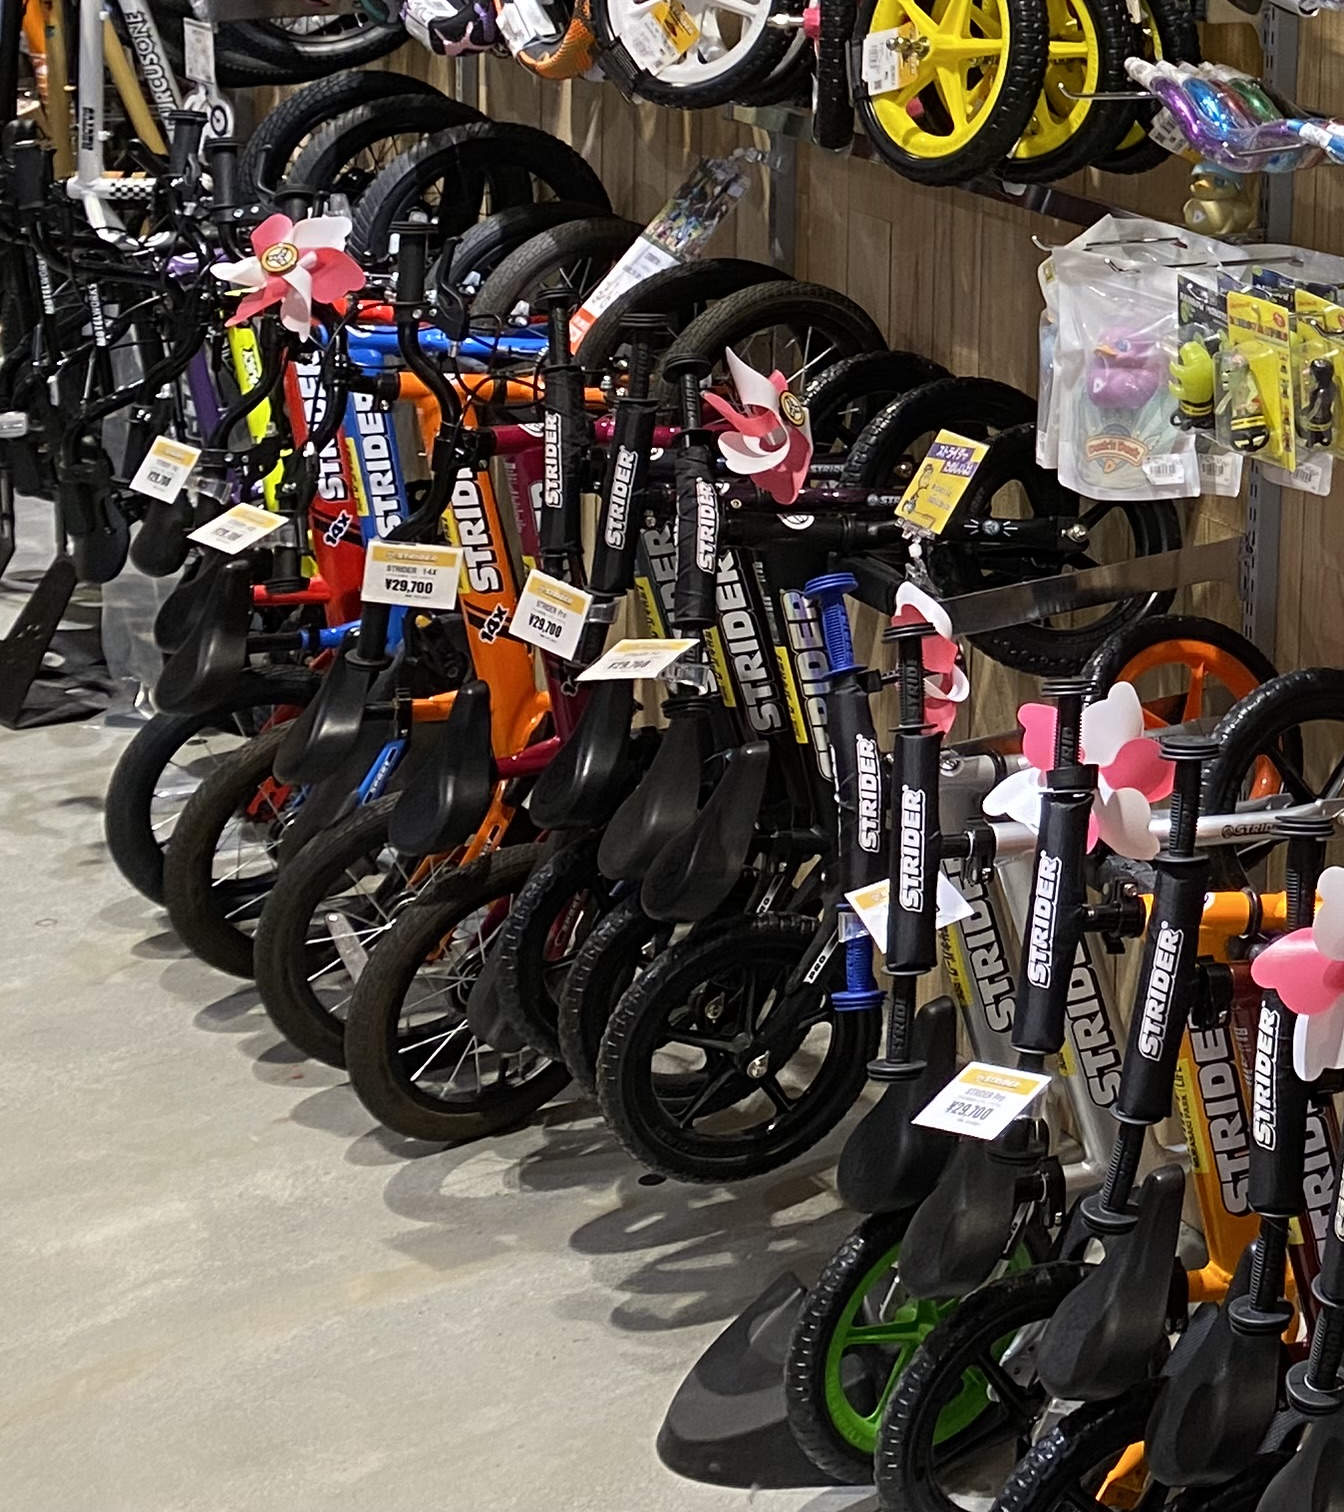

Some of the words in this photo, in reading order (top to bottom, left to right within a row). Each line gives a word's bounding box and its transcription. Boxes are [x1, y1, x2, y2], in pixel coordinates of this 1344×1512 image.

[545, 410, 563, 509] STRIDER
[605, 445, 640, 551] STRIDER
[936, 444, 970, 464] ストライダー
[323, 509, 354, 548] 14X
[386, 565, 419, 576] STRIDER
[695, 477, 720, 575] STRIDER
[383, 577, 434, 597] ¥29,700
[479, 603, 509, 645] 14X
[528, 612, 563, 639] ¥29,700
[856, 734, 883, 854] STRIDER
[900, 785, 928, 913] STRIDER
[806, 954, 830, 983] PRO
[1027, 850, 1063, 989] STRIDER
[1138, 921, 1184, 1062] STRIDER
[946, 1100, 992, 1123] ¥29,700
[1187, 1015, 1253, 1218] STRIDE
[1252, 1000, 1282, 1152] STRIDER
